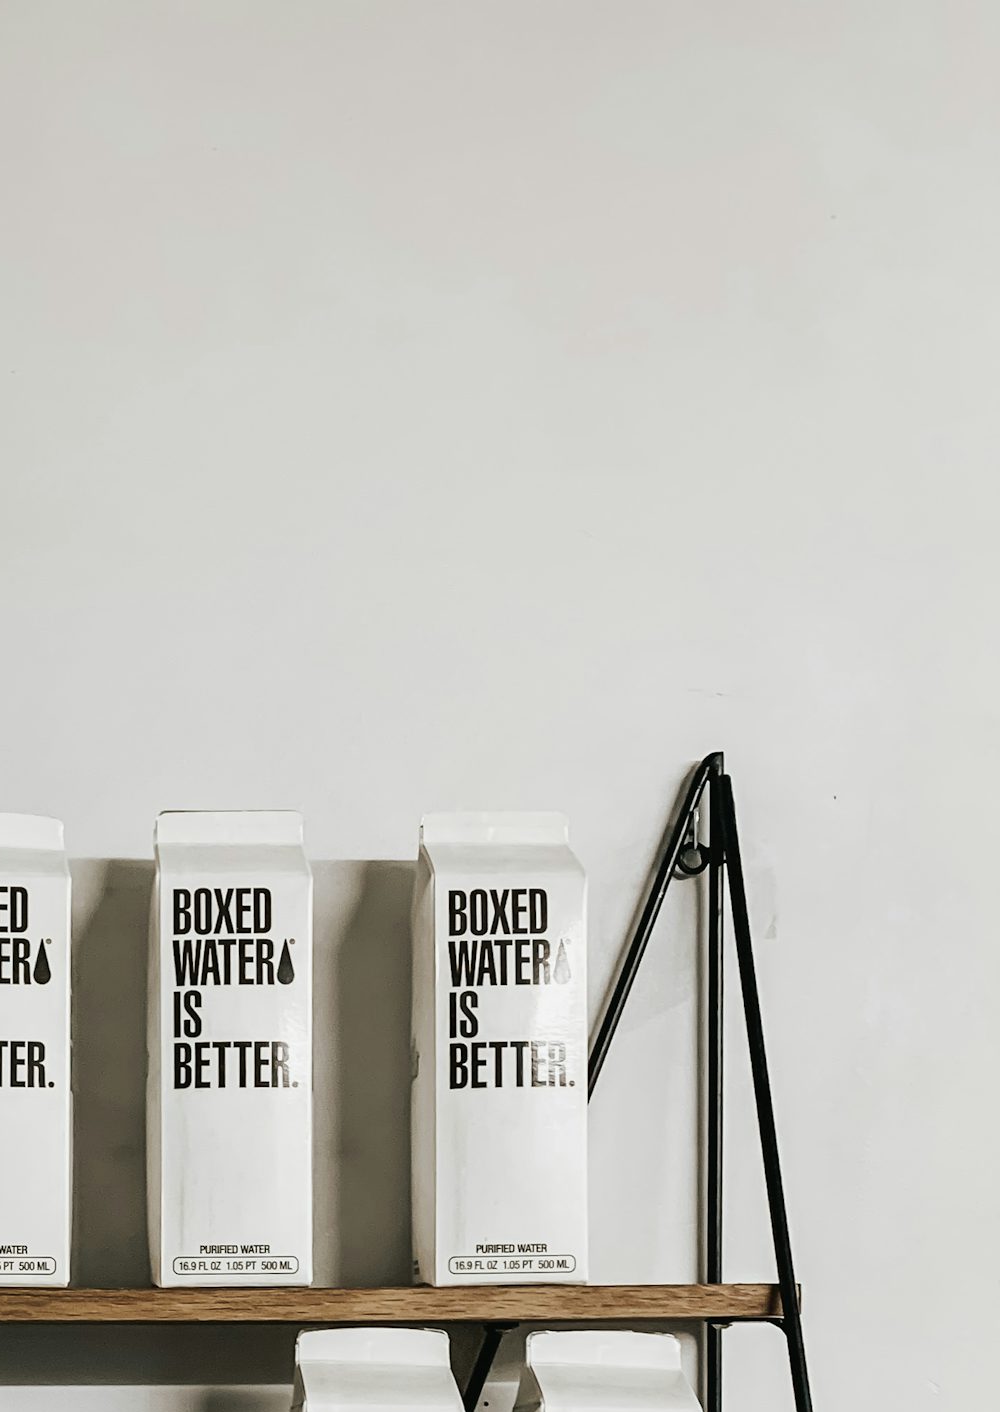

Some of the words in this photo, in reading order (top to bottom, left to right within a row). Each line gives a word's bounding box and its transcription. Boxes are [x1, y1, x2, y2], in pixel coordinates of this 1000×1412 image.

[173, 888, 271, 935] BOXED
[449, 889, 547, 936] BOXED
[173, 939, 274, 986] WATER
[448, 939, 550, 987] WATER
[174, 990, 202, 1038] IS
[449, 991, 478, 1038] IS
[174, 1041, 298, 1089] BETTER.
[450, 1041, 575, 1089] BETTER.
[3, 1262, 14, 1271] PT
[18, 1262, 35, 1271] 500
[36, 1262, 50, 1271] ML
[179, 1262, 196, 1271] 16.9
[198, 1261, 208, 1270] FL
[210, 1261, 221, 1271] OZ
[226, 1261, 243, 1270] 1.05
[245, 1261, 257, 1270] PT
[261, 1261, 278, 1270] 500
[279, 1261, 293, 1270] ML
[199, 1245, 239, 1254] PURIFIED
[240, 1245, 270, 1254] WATER
[455, 1261, 472, 1270] 16.9
[474, 1261, 485, 1270] FL
[486, 1260, 498, 1270] OZ
[503, 1260, 520, 1269] 1.05
[522, 1260, 534, 1269] PT
[538, 1260, 555, 1269] 500
[556, 1259, 570, 1269] ML
[476, 1244, 515, 1254] PURIFIED
[517, 1243, 548, 1253] WATER
